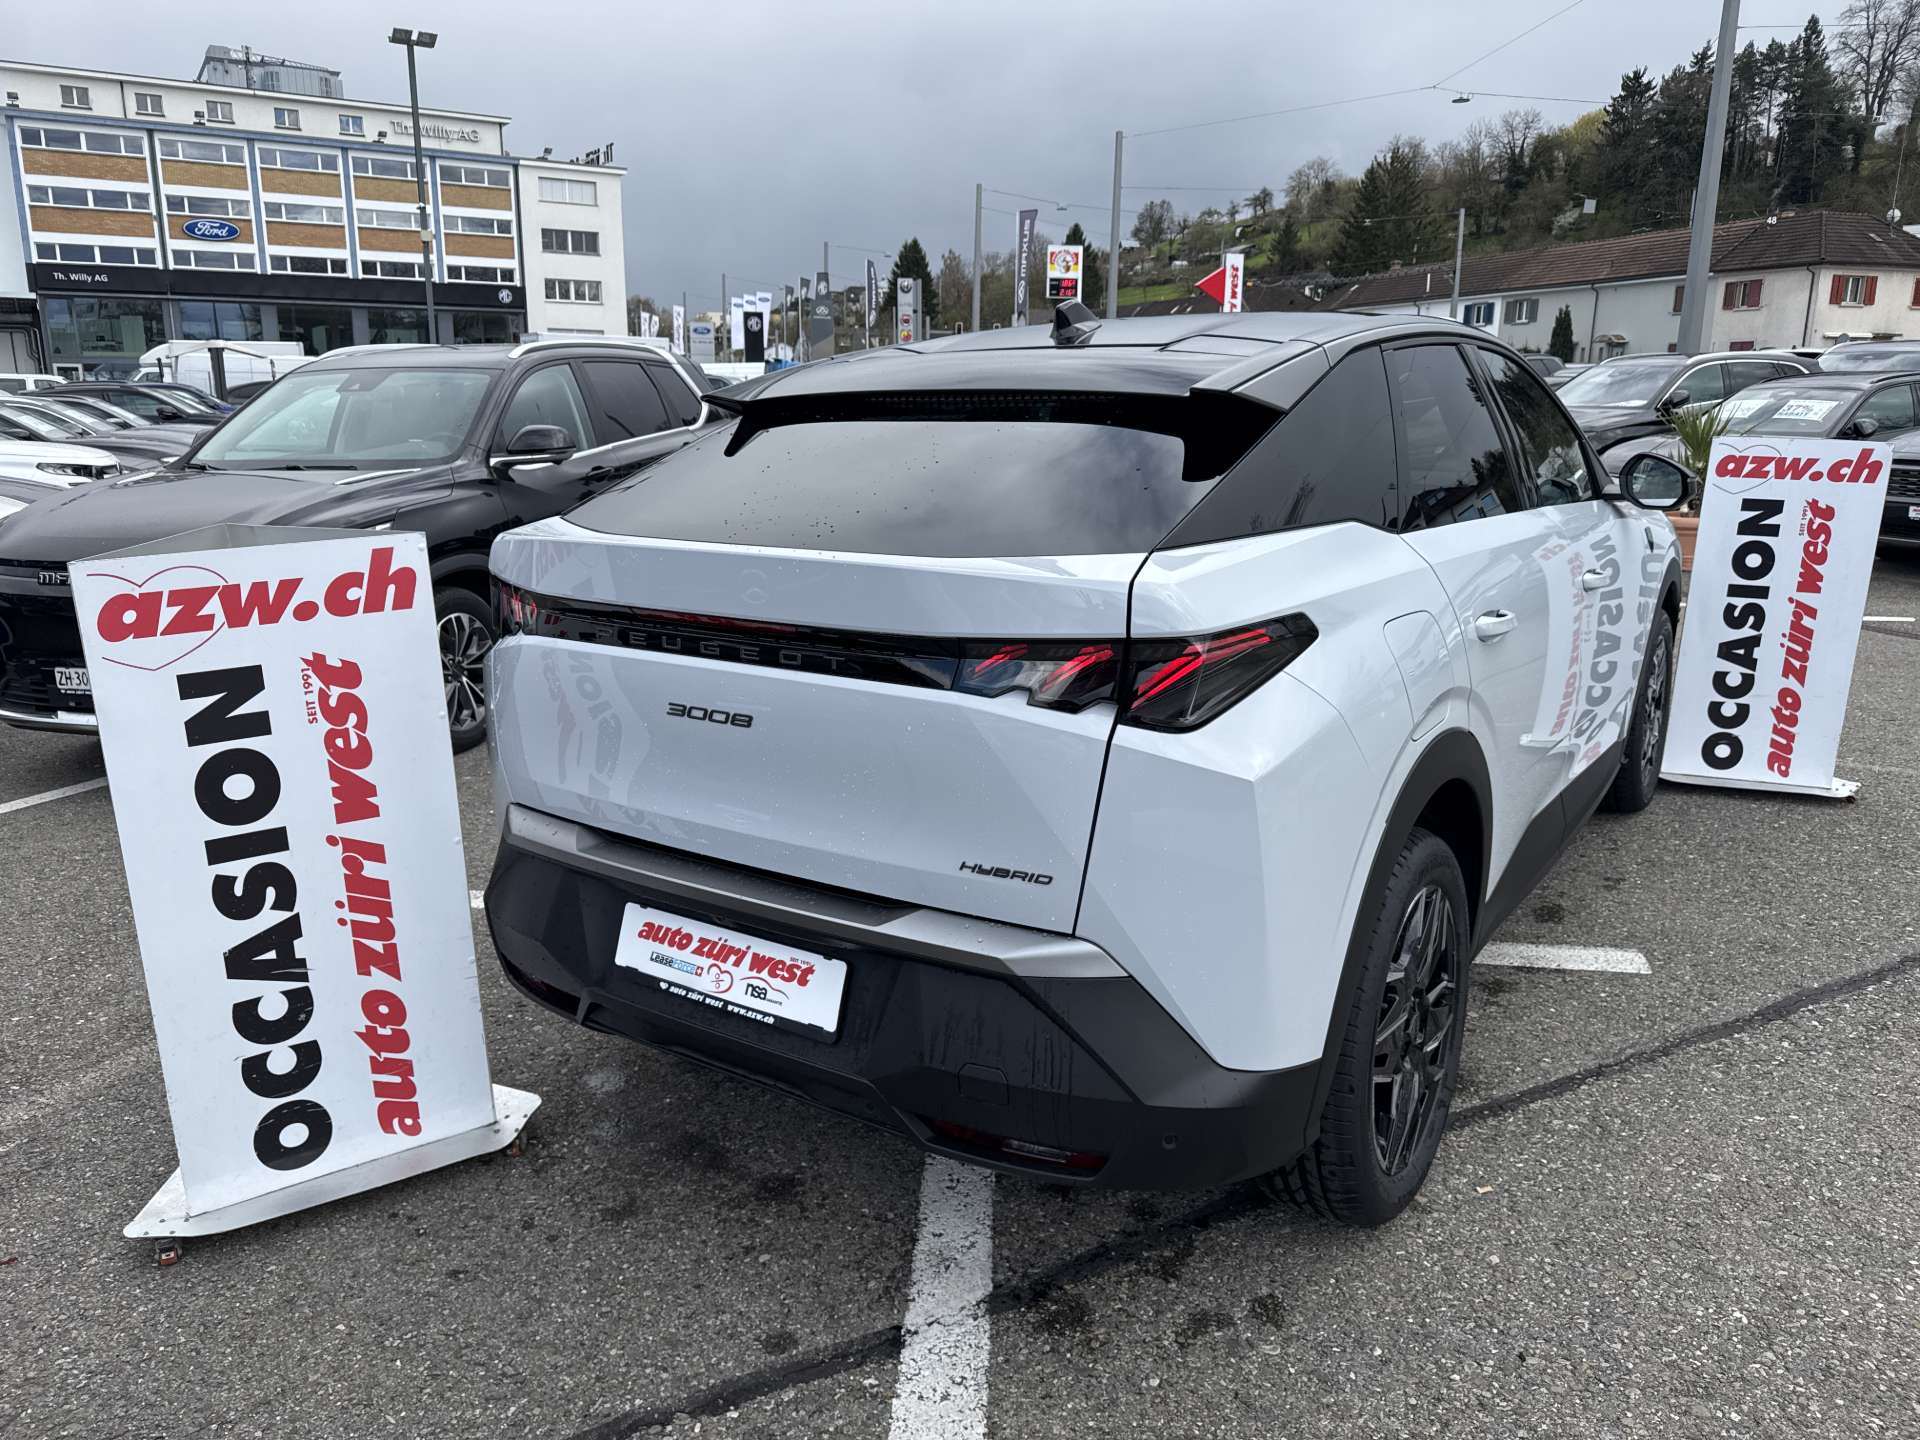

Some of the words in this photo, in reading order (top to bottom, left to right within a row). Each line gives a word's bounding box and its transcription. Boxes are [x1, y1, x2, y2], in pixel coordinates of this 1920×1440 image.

[420, 122, 454, 142] Willy
[459, 128, 480, 142] AG
[194, 221, 229, 237] Ford
[1766, 216, 1777, 225] 48
[53, 271, 67, 281] Th.
[69, 273, 92, 283] Willy
[94, 274, 109, 282] AG
[747, 316, 761, 332] MG
[1714, 448, 1883, 484] azw.ch
[1796, 498, 1837, 594] west
[97, 546, 417, 643] azw.ch
[594, 626, 846, 671] PEUGEOT
[1701, 498, 1785, 770] OCCASION
[1779, 596, 1818, 688] züri
[301, 667, 314, 696] 1991
[306, 700, 319, 725] SEIT
[666, 702, 754, 728] 3008
[1767, 687, 1801, 778] auto
[300, 650, 381, 825] west
[959, 861, 1053, 885] HYBRID
[176, 664, 334, 1171] OCCASION
[325, 834, 402, 982] züri
[637, 920, 693, 951] auto
[691, 937, 751, 968] züri
[749, 952, 816, 987] west
[668, 985, 687, 996] auto
[705, 997, 724, 1009] west
[727, 1004, 776, 1025] www.azw.ch
[744, 982, 768, 1001] nsa
[353, 988, 423, 1137] auto
